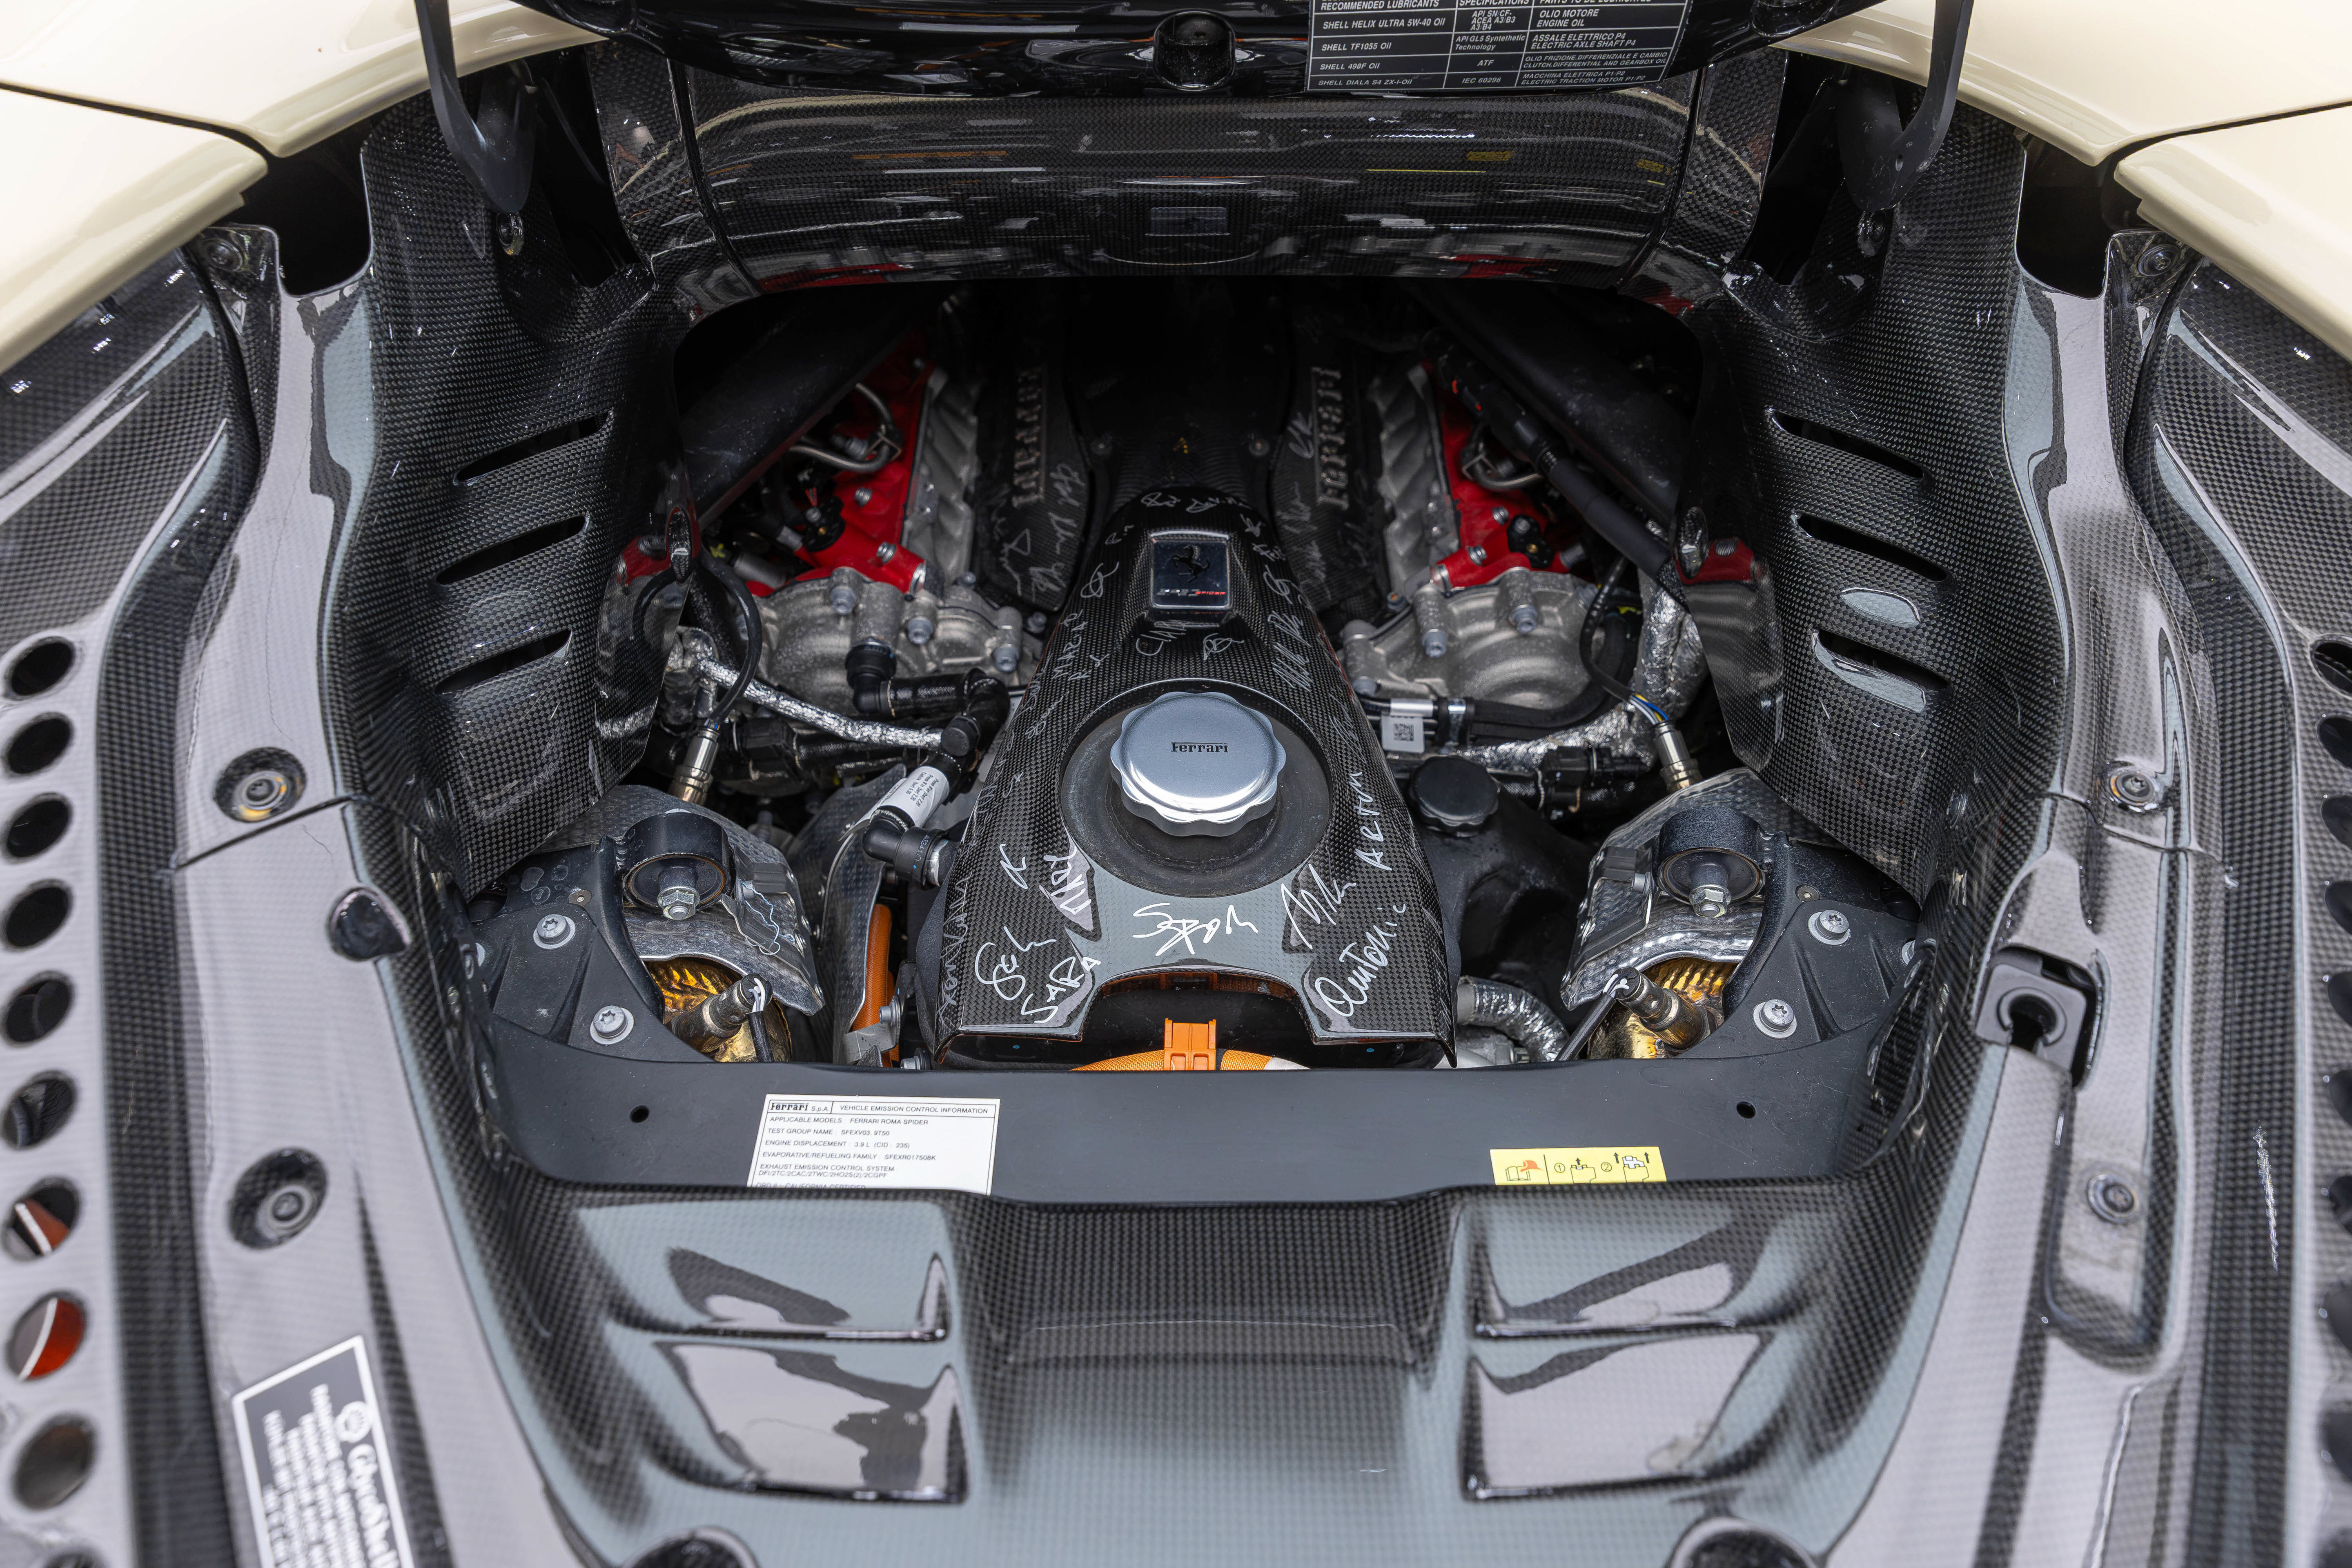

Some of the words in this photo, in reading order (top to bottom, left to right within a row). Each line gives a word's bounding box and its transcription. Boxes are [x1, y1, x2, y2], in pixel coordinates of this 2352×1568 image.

[1321, 1, 1384, 11] RECOMMENDED
[1387, 0, 1439, 8] LUBRICANTS
[1539, 10, 1560, 18] OLIO
[1562, 9, 1599, 18] MOTORE
[1323, 21, 1349, 29] SHELL
[1352, 20, 1376, 29] HELIX
[1379, 19, 1405, 28] ULTRA
[1407, 18, 1431, 27] 5W-40
[1321, 43, 1347, 51] SHELL
[1171, 742, 1229, 753] Ferrari
[770, 1102, 809, 1111] Ferrari
